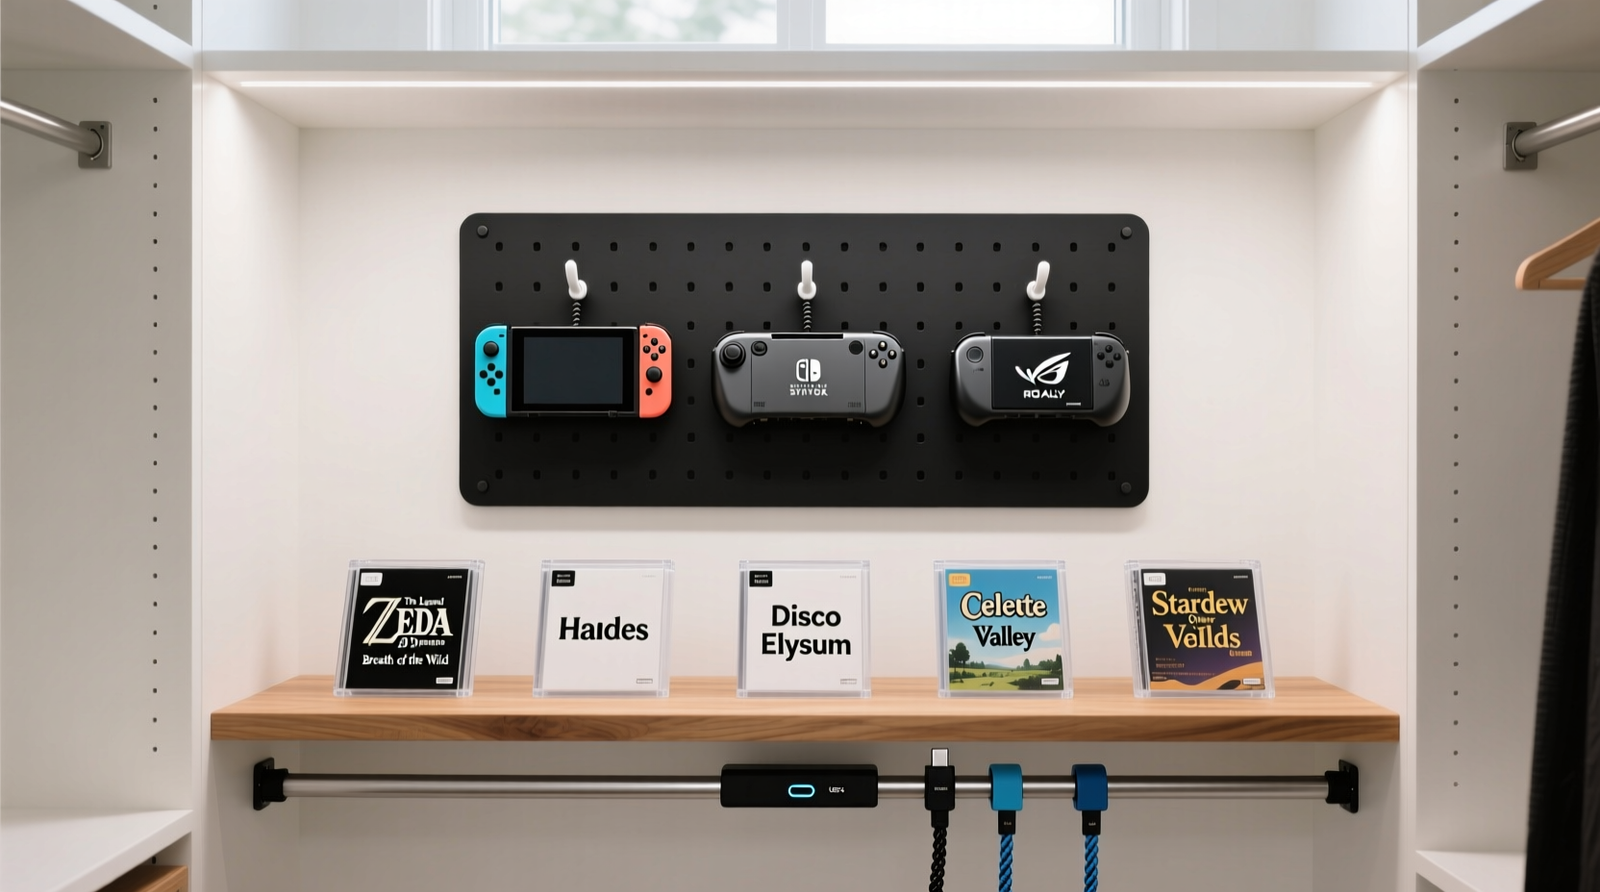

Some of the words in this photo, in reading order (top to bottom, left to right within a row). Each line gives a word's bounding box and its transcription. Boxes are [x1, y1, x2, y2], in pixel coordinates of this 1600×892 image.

[772, 603, 841, 627] Disco
[1151, 590, 1249, 616] Stardew
[761, 632, 851, 662] Elysum
[972, 625, 1036, 652] Valley
